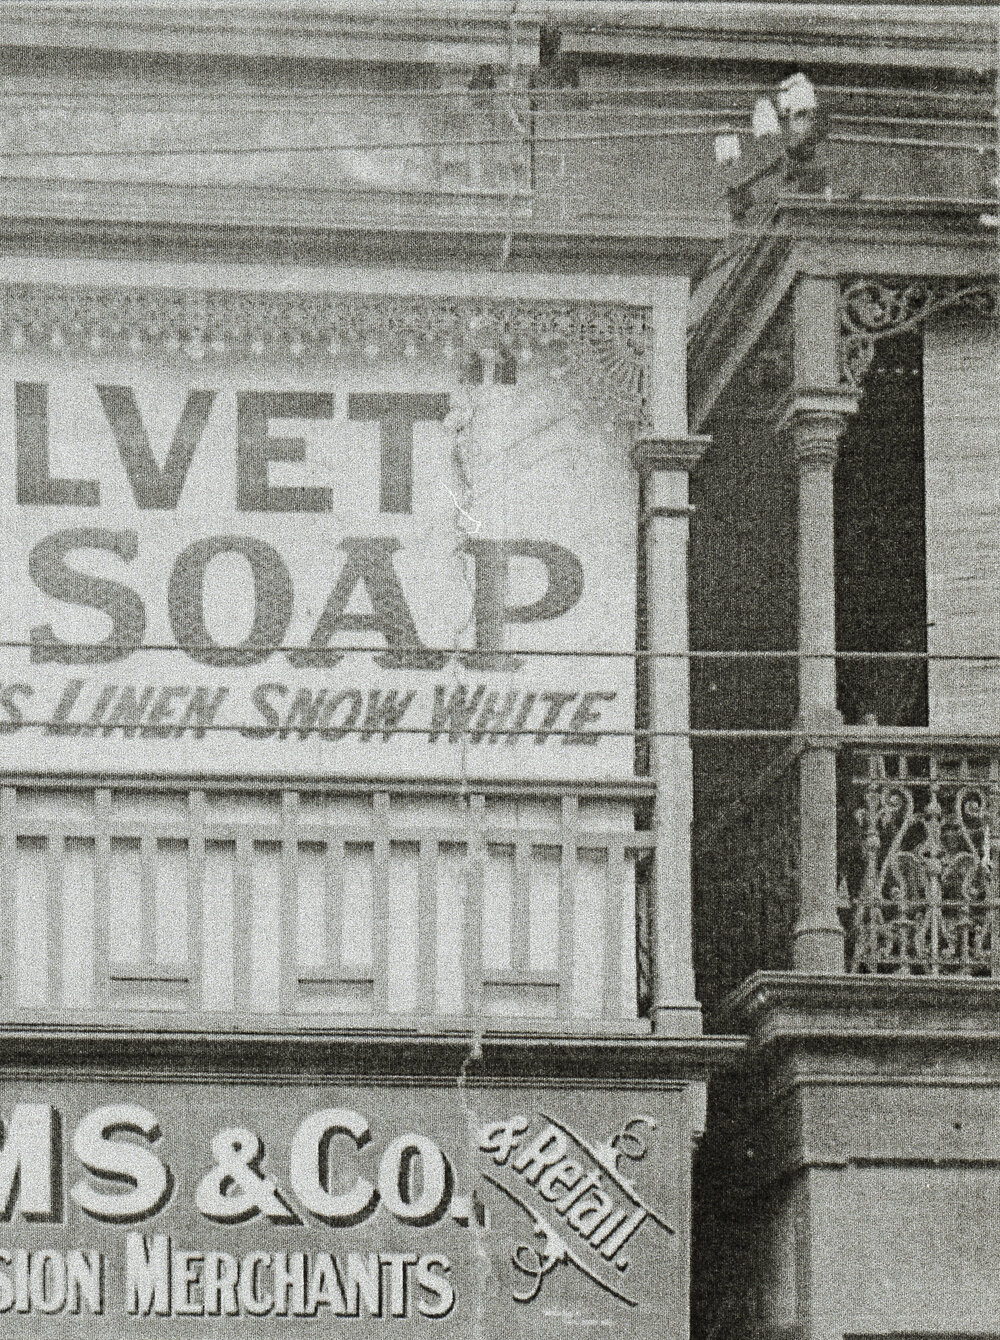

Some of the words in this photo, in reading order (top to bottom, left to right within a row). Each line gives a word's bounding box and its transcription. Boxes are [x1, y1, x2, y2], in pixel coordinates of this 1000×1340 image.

[26, 526, 586, 672] SOAP
[43, 678, 232, 740] LINEN
[238, 682, 416, 744] SNOW
[426, 684, 617, 748] WHITE
[125, 1232, 458, 1320] MERCHANTS
